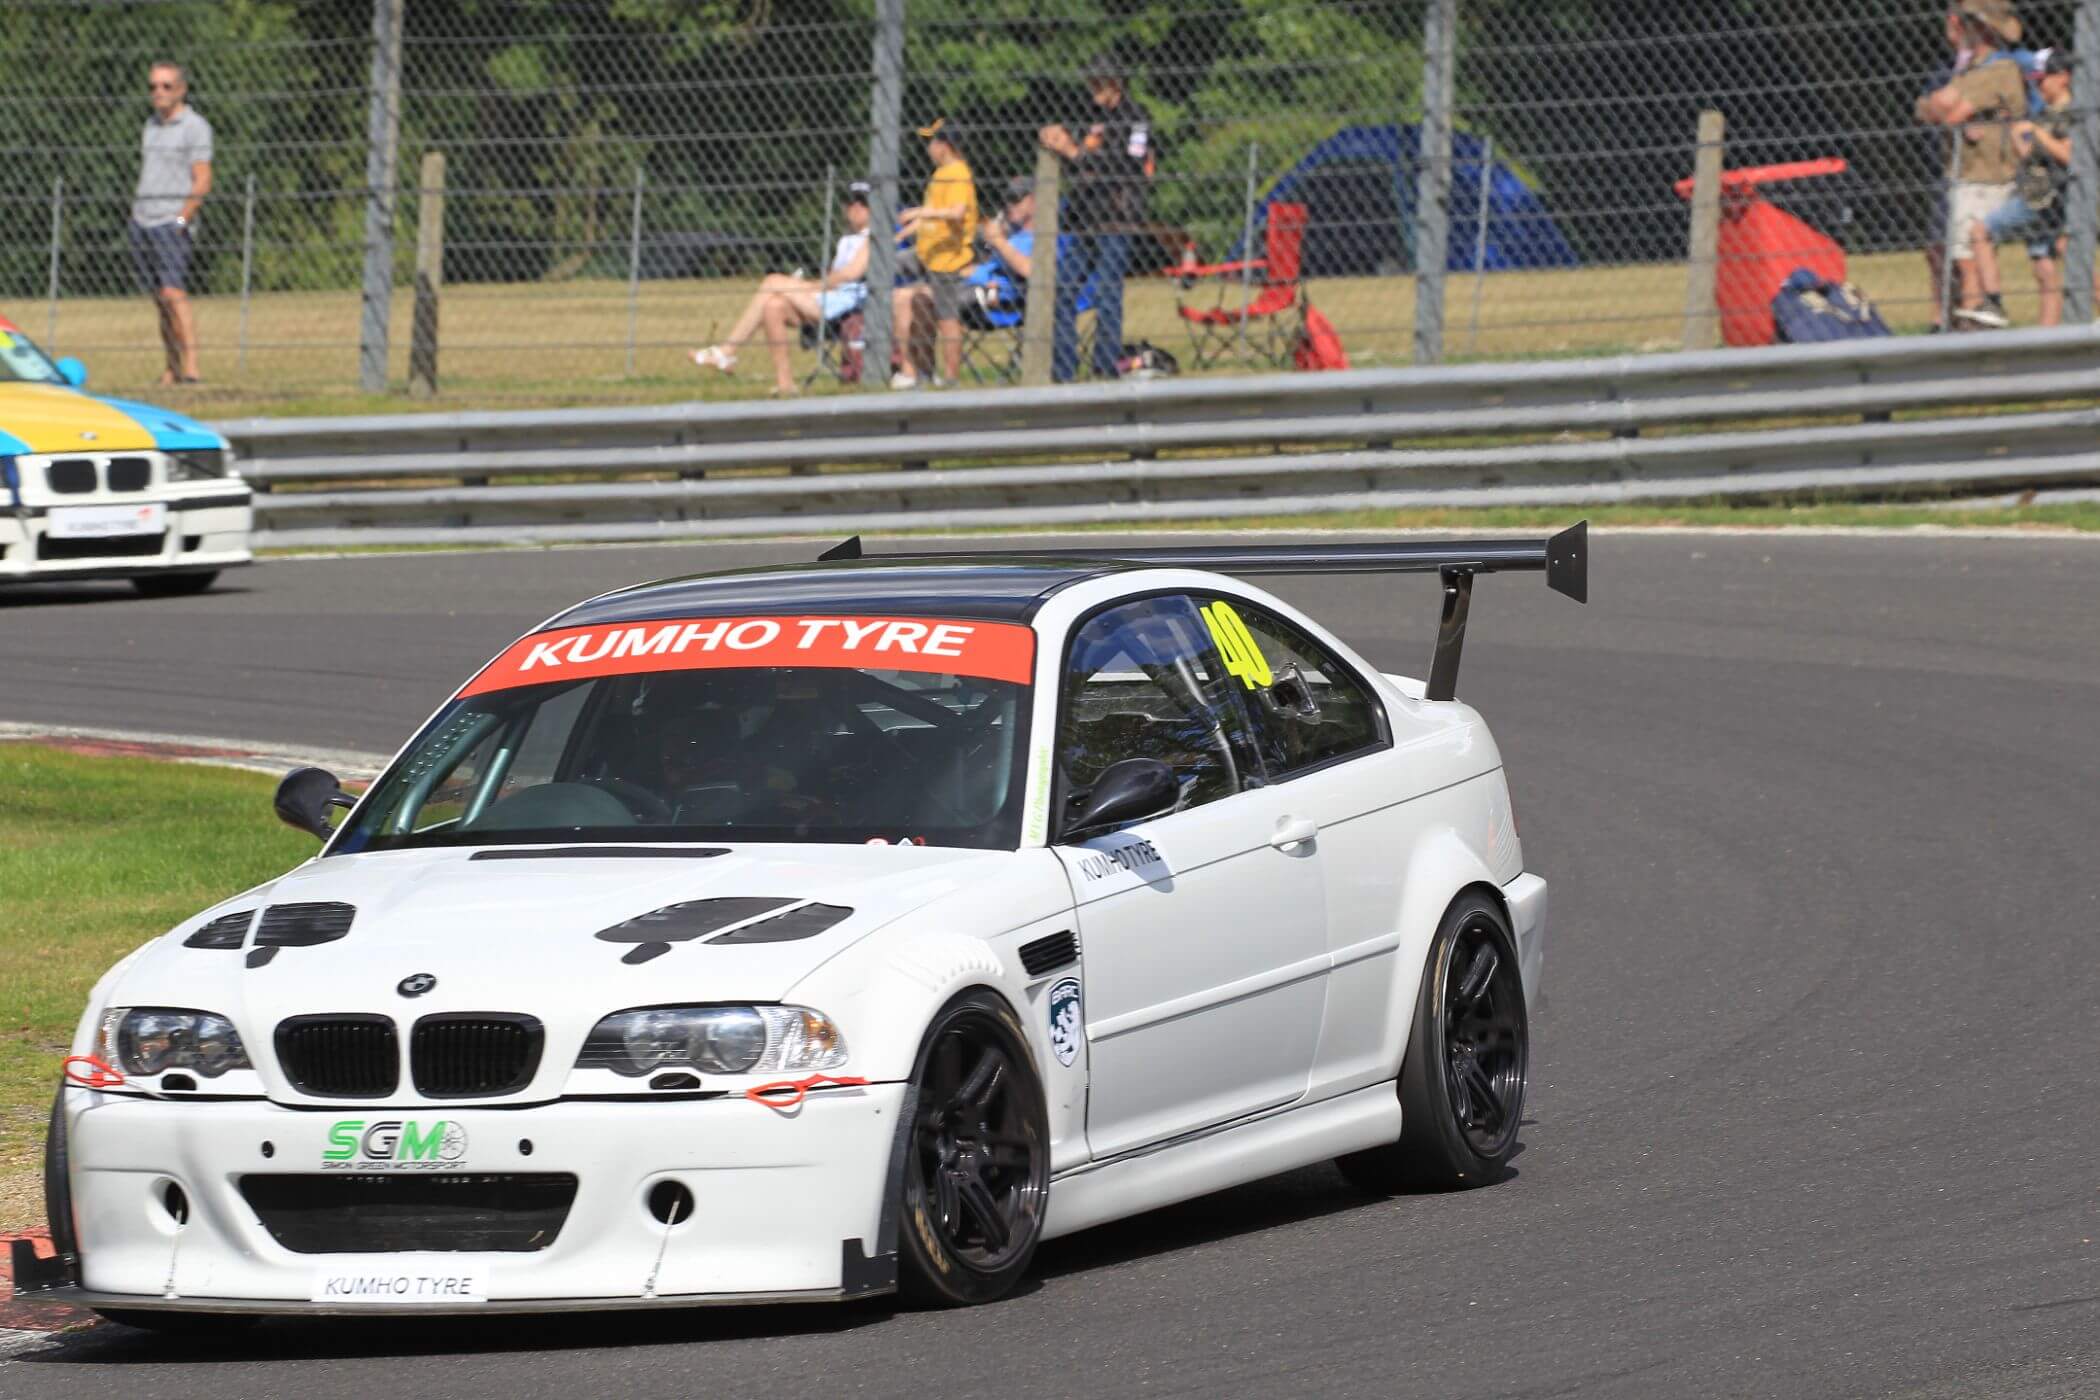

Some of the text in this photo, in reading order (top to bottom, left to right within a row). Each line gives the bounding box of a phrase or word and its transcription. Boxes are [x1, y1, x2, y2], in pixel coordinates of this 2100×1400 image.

[519, 619, 975, 672] KUMHO TYRE
[1200, 601, 1273, 690] 40
[1079, 839, 1161, 881] KUMHO TYRE
[322, 1120, 448, 1160] SGM
[325, 1276, 473, 1295] KUMHO TYRE
